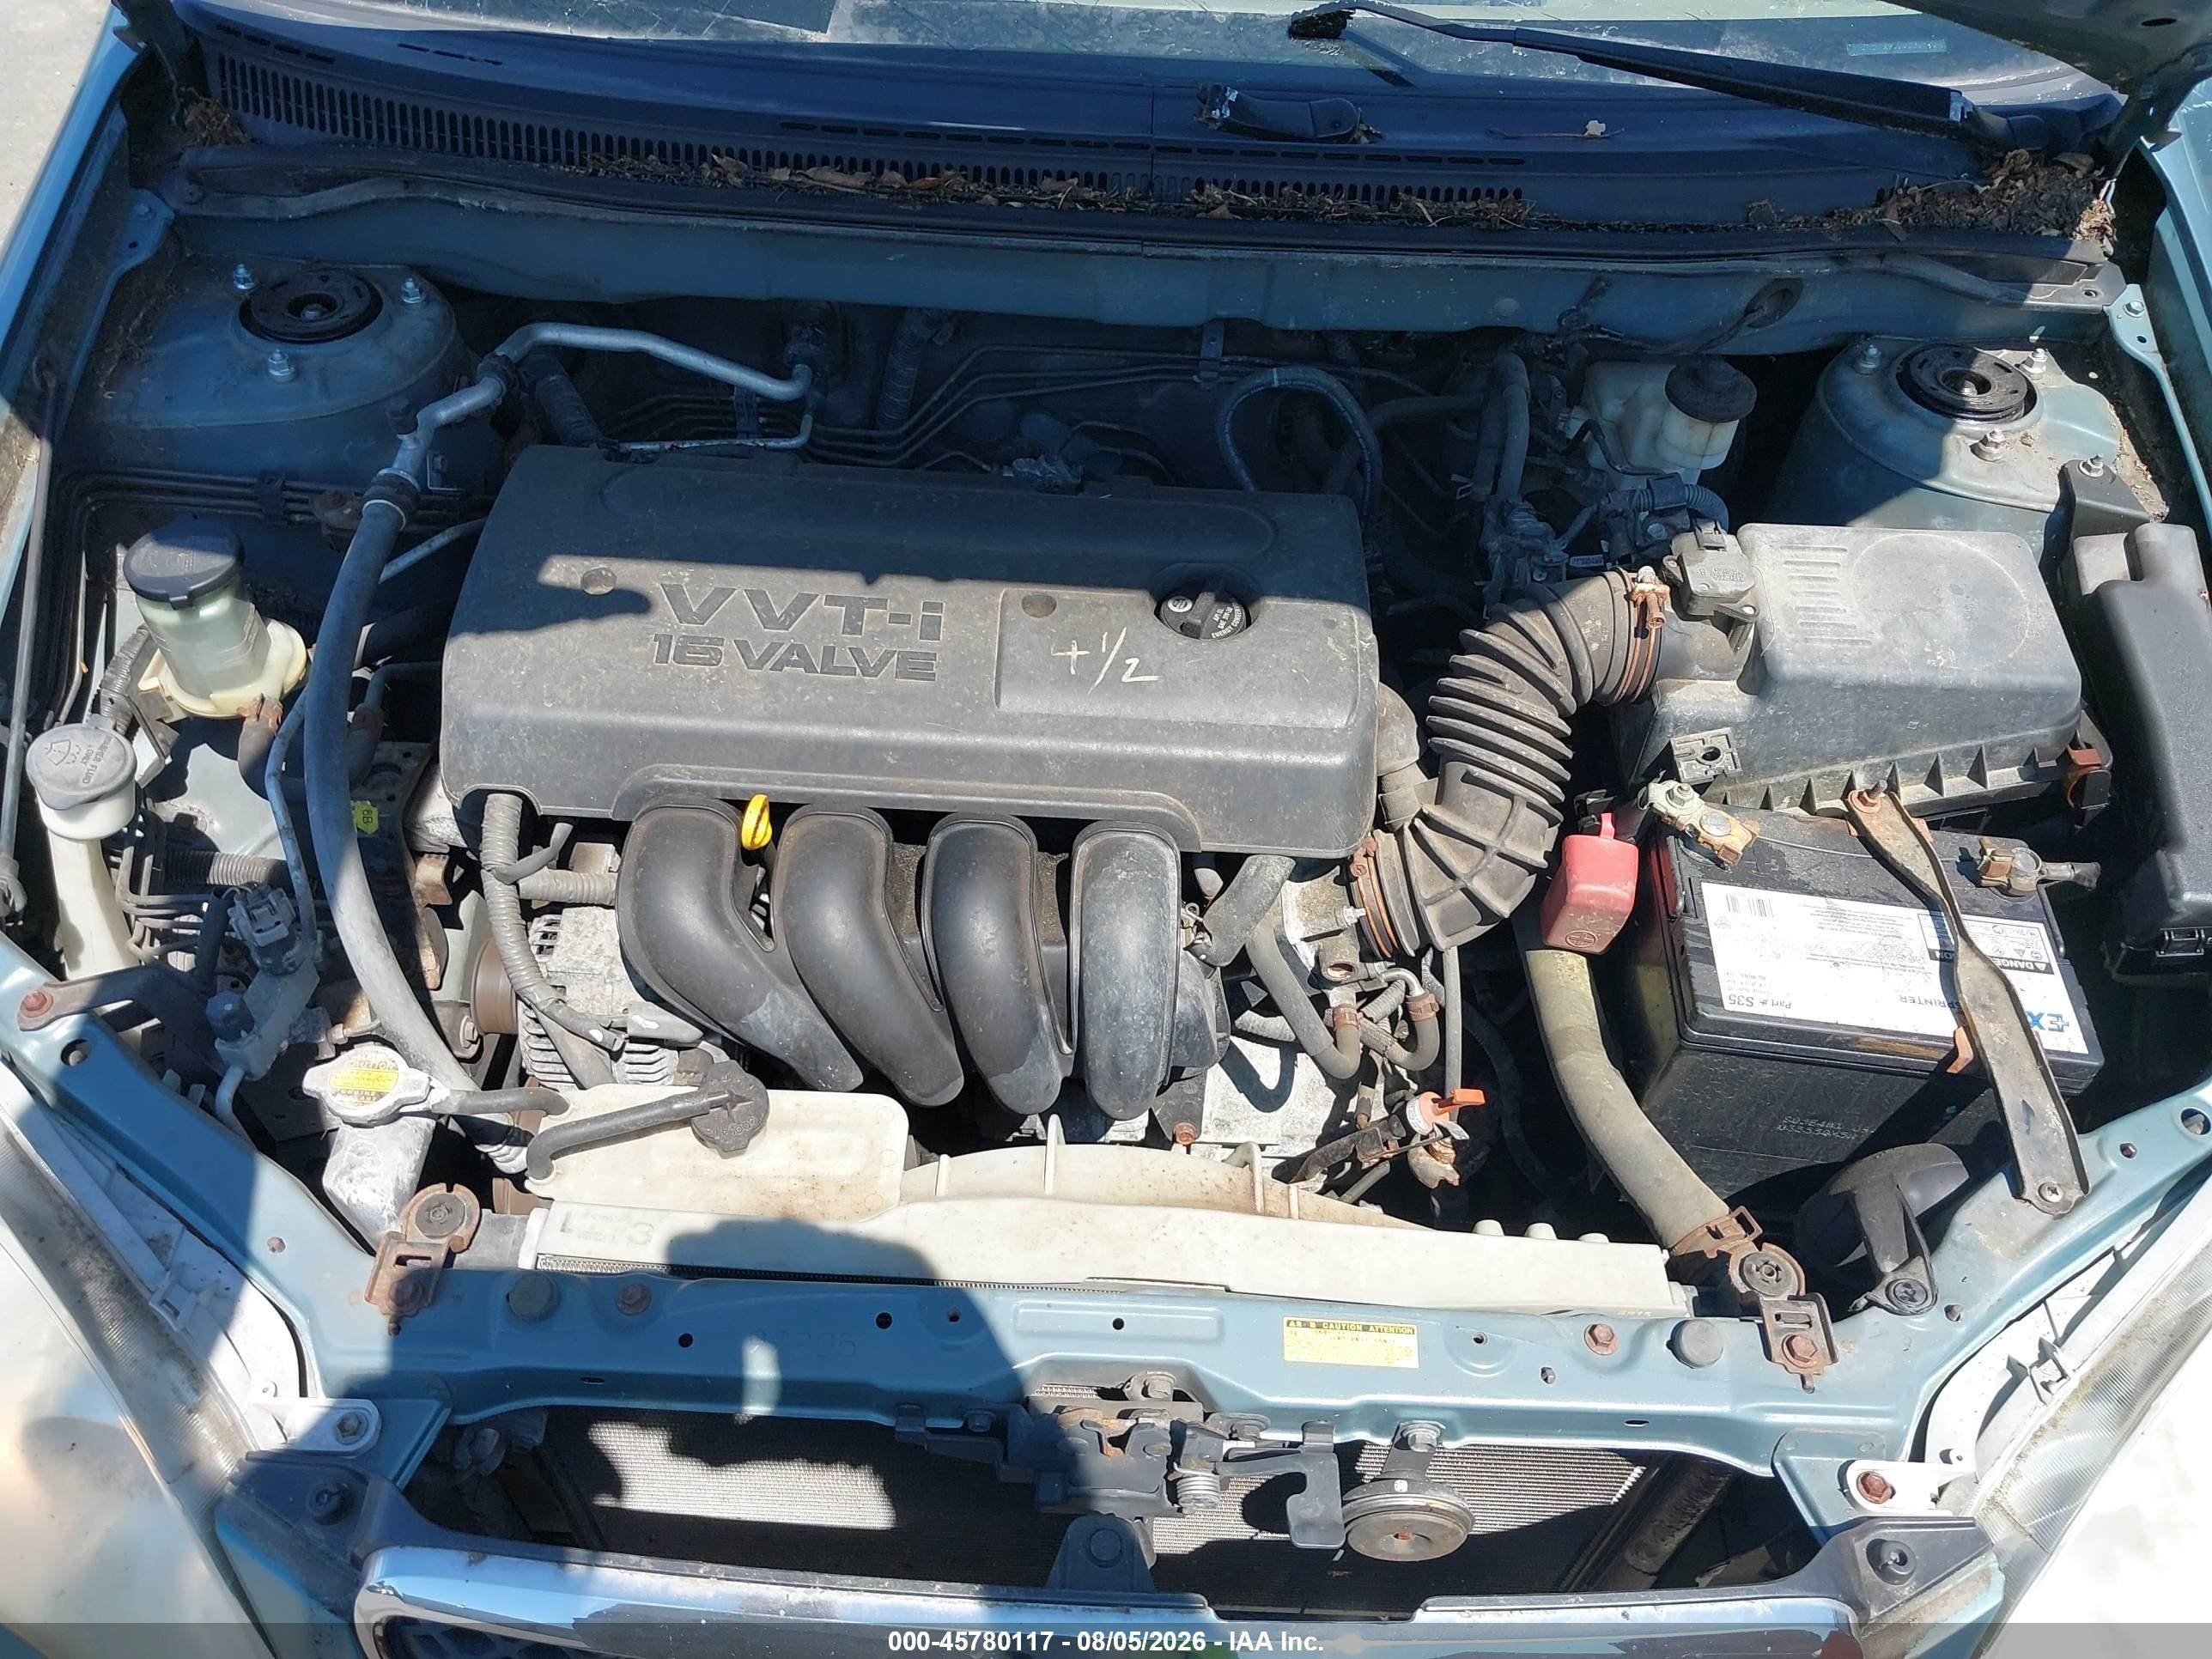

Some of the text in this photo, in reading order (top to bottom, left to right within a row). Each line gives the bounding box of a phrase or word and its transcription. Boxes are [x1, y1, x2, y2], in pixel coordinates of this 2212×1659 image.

[660, 583, 944, 641] VVT-i
[1211, 625, 1234, 638] ENERGY
[653, 633, 939, 682] 16 VALVE
[1991, 957, 2034, 970] DANGE
[1729, 994, 1754, 1007] S35
[2025, 1010, 2070, 1033] EX
[1322, 1322, 1363, 1331] CAUTION
[1369, 1325, 1413, 1334] ATTENTION
